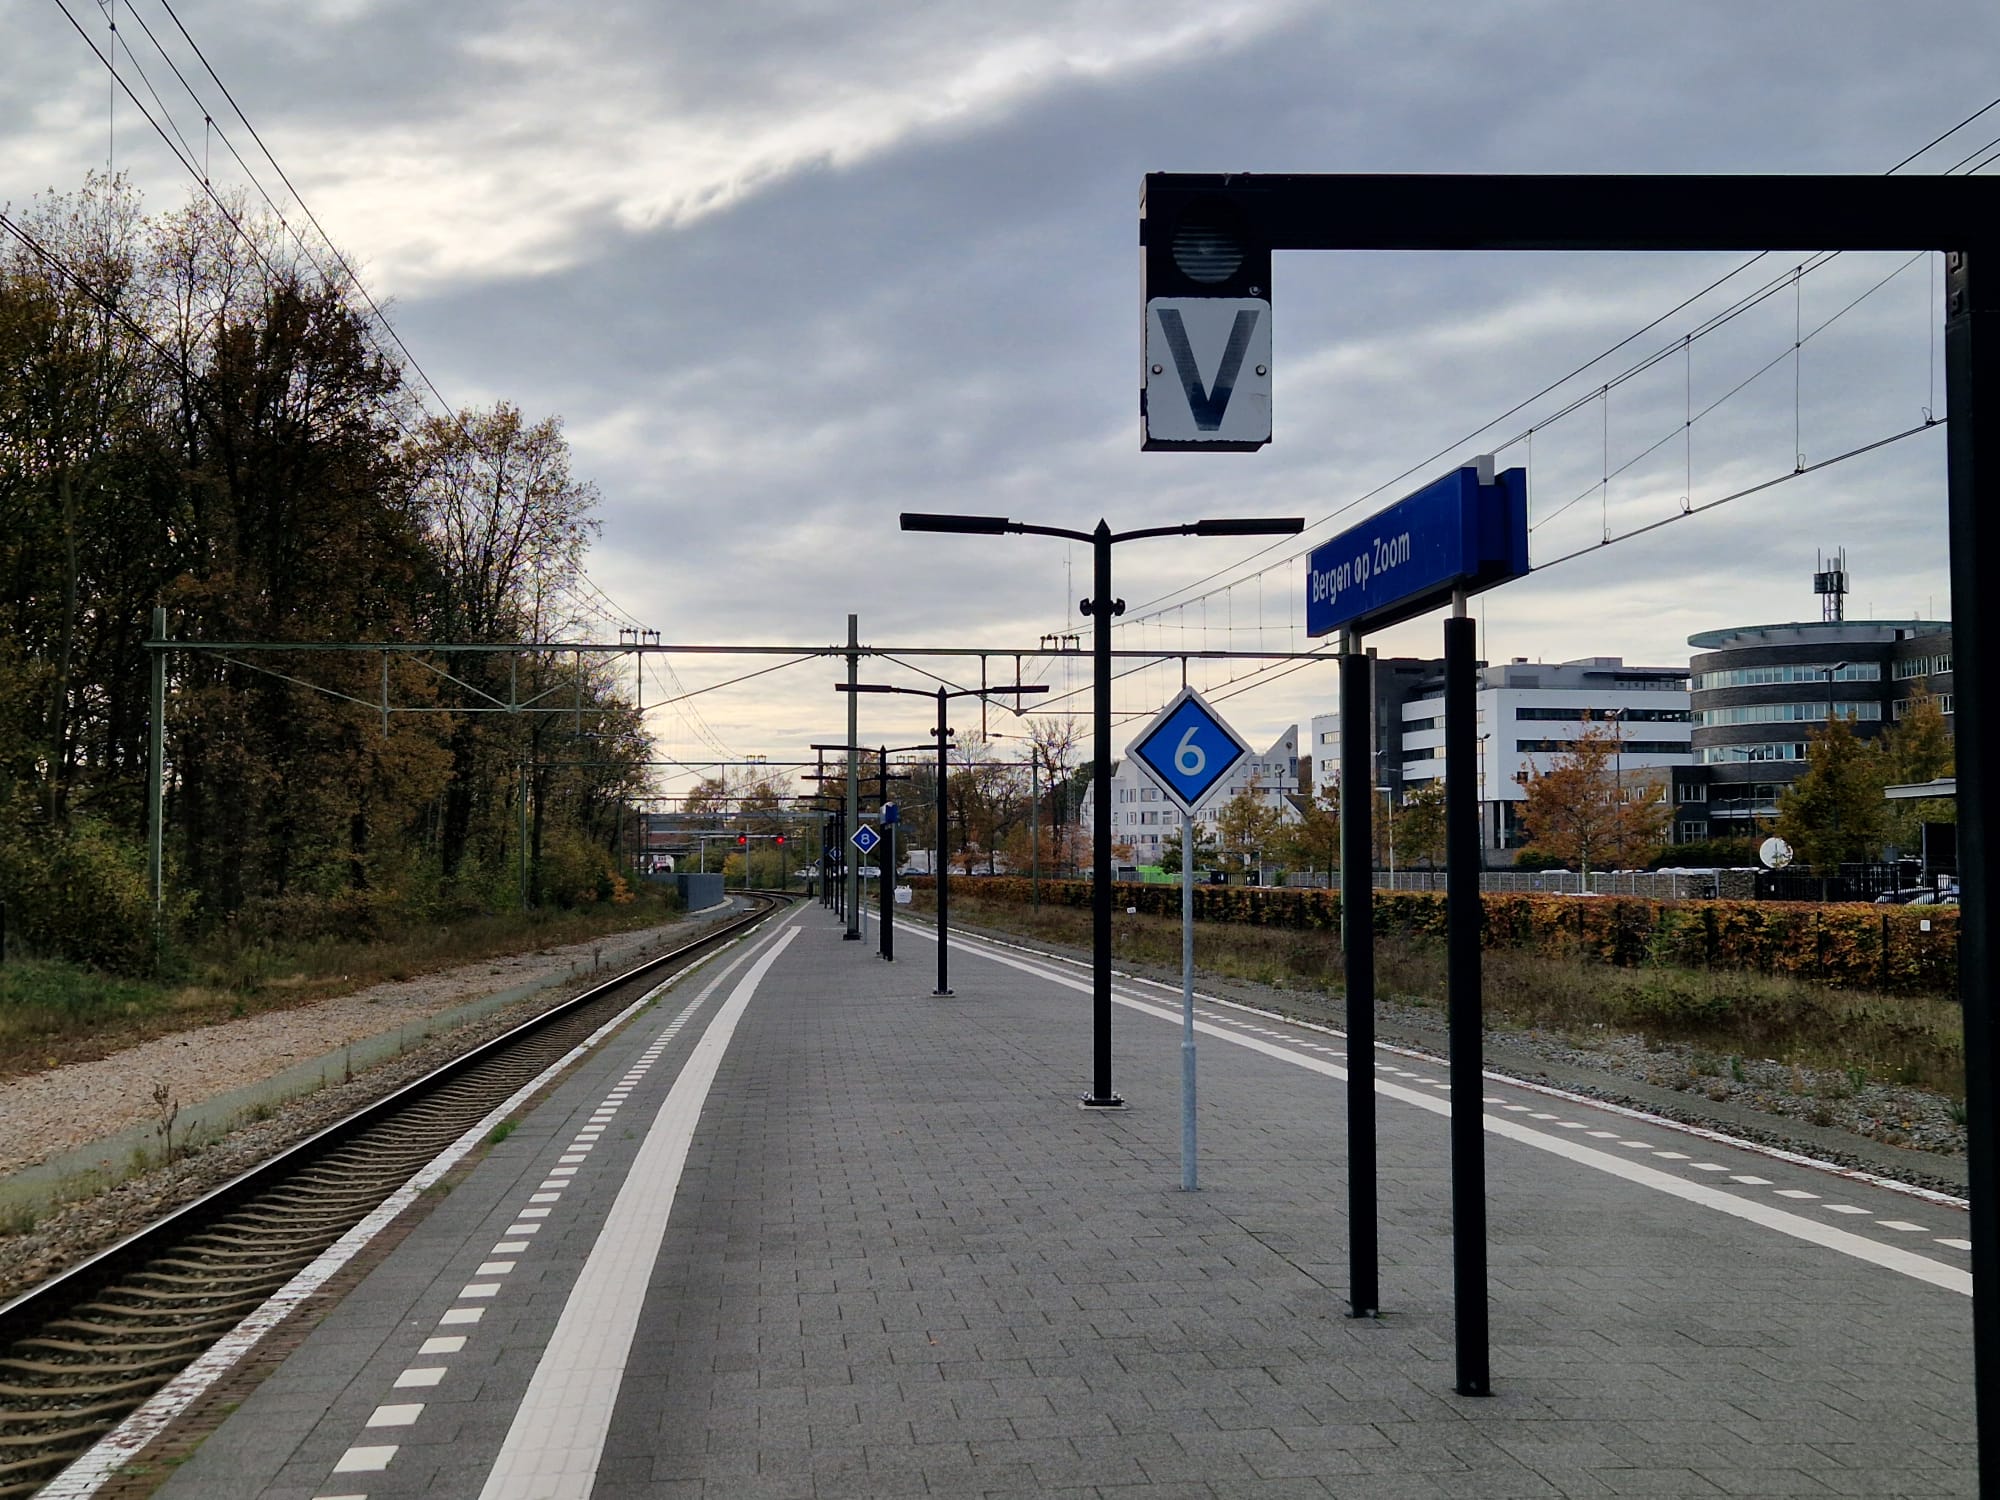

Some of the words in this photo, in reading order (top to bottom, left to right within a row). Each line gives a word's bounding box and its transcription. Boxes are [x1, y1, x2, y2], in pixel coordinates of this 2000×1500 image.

[1156, 308, 1260, 431] V
[1312, 562, 1351, 605] Bergen
[1354, 552, 1370, 591] op
[1373, 531, 1410, 576] Zoom
[1174, 726, 1206, 776] 6
[860, 833, 870, 845] 8
